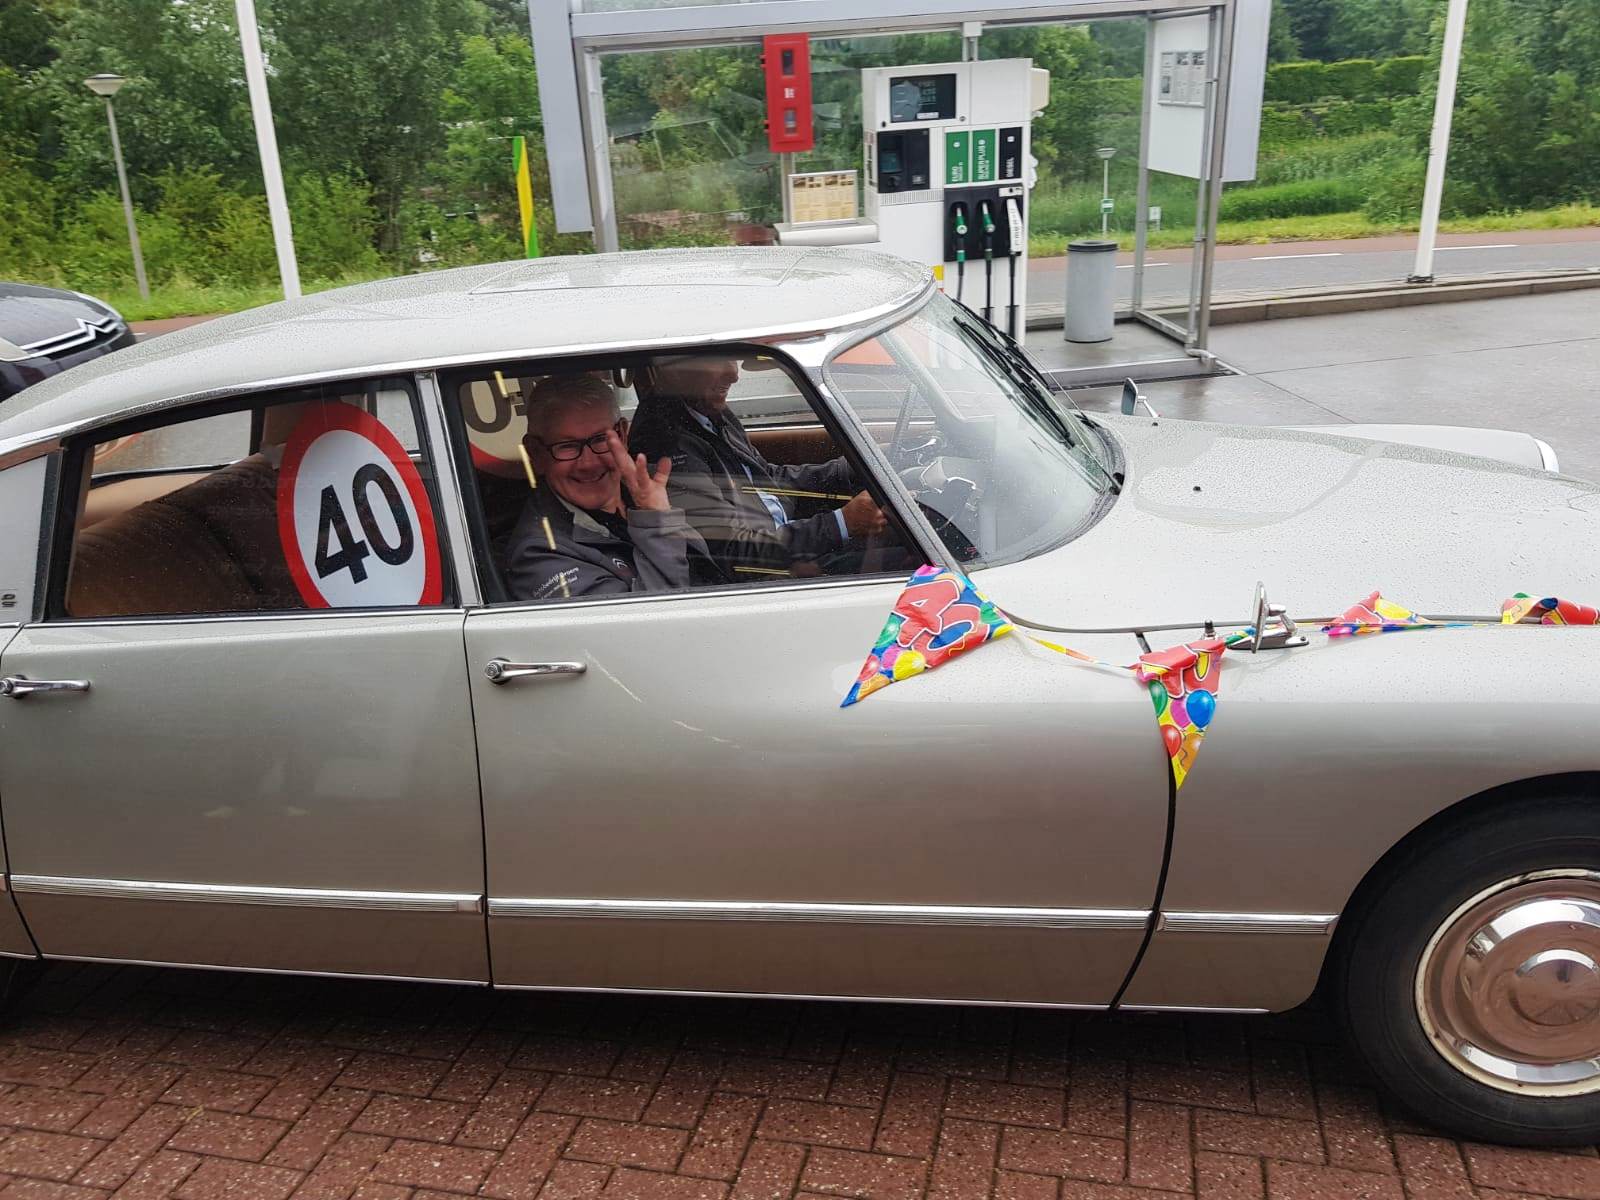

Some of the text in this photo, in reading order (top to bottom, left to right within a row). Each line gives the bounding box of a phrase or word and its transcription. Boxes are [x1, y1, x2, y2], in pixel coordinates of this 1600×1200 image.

[1006, 157, 1014, 178] DIESEL
[314, 463, 414, 584] 40
[891, 579, 990, 669] 40
